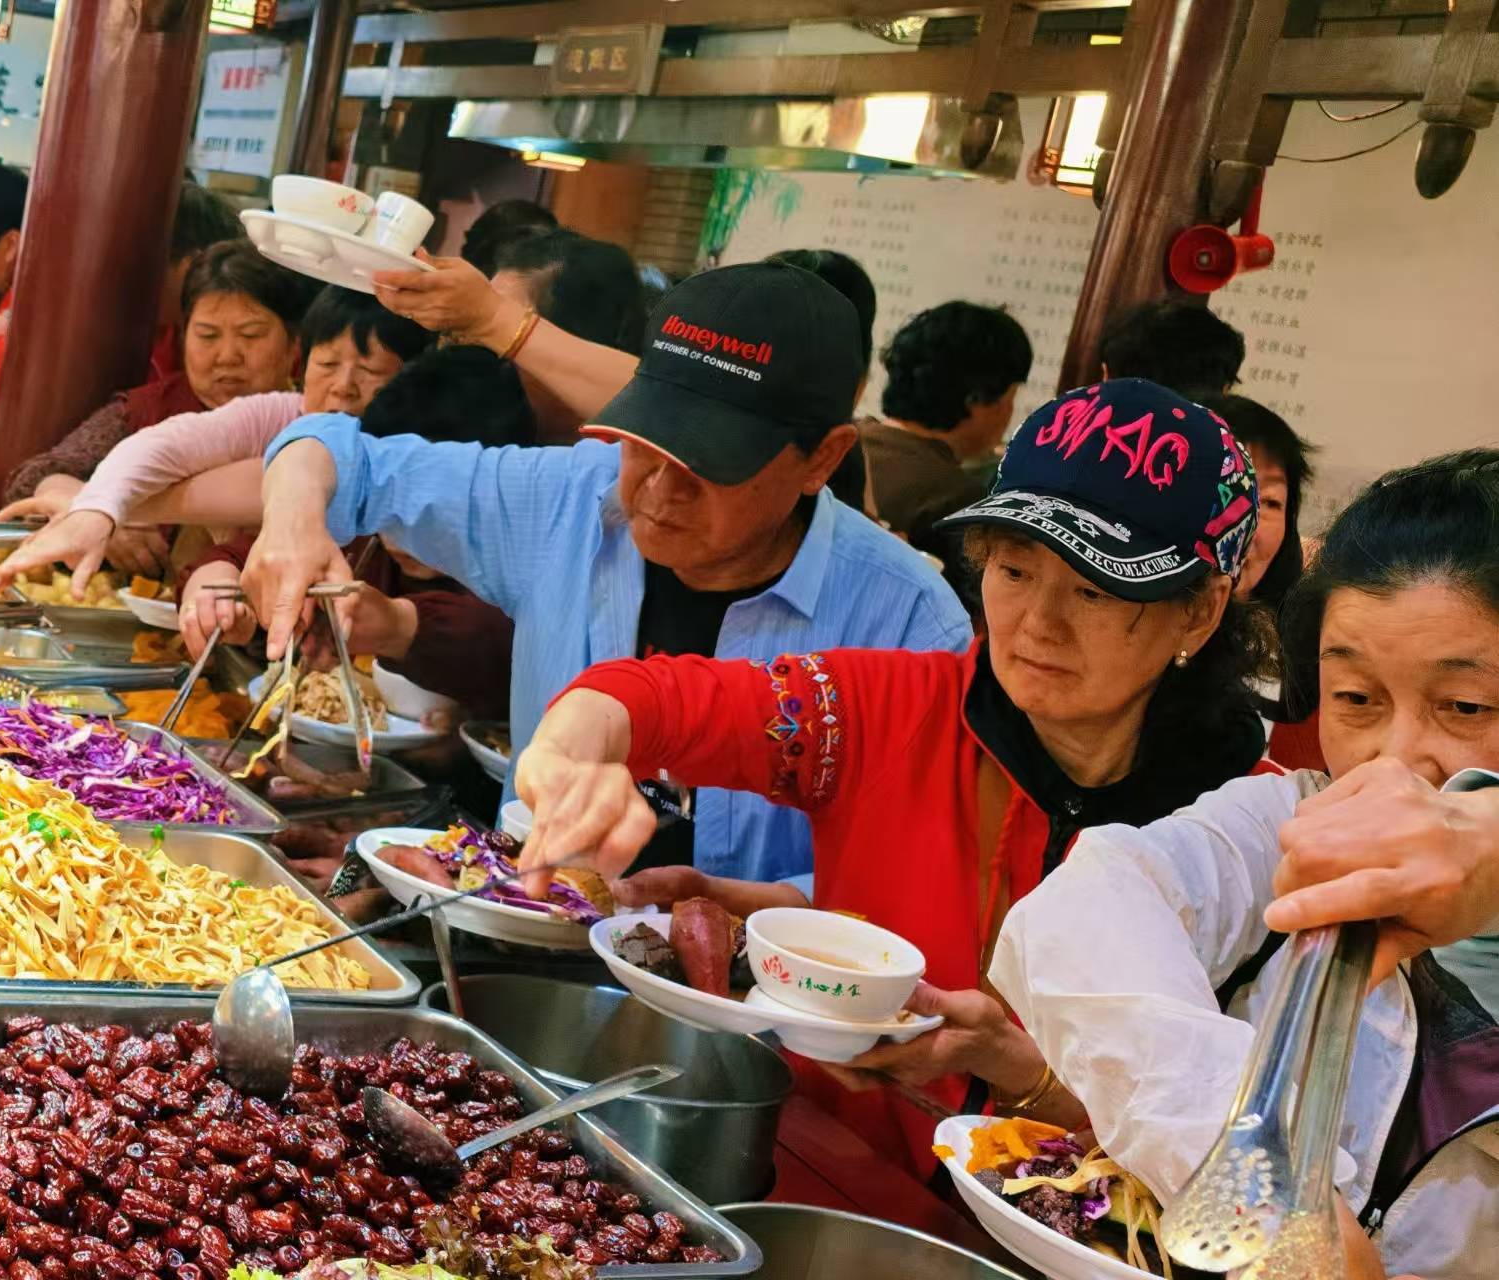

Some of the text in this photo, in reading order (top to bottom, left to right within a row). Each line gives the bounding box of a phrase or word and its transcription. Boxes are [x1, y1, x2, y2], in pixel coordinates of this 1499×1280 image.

[661, 314, 773, 365] Honeywell
[664, 342, 689, 358] POWER
[689, 350, 703, 361] OF
[702, 354, 761, 382] CONNECTED
[1040, 520, 1080, 550] WILL
